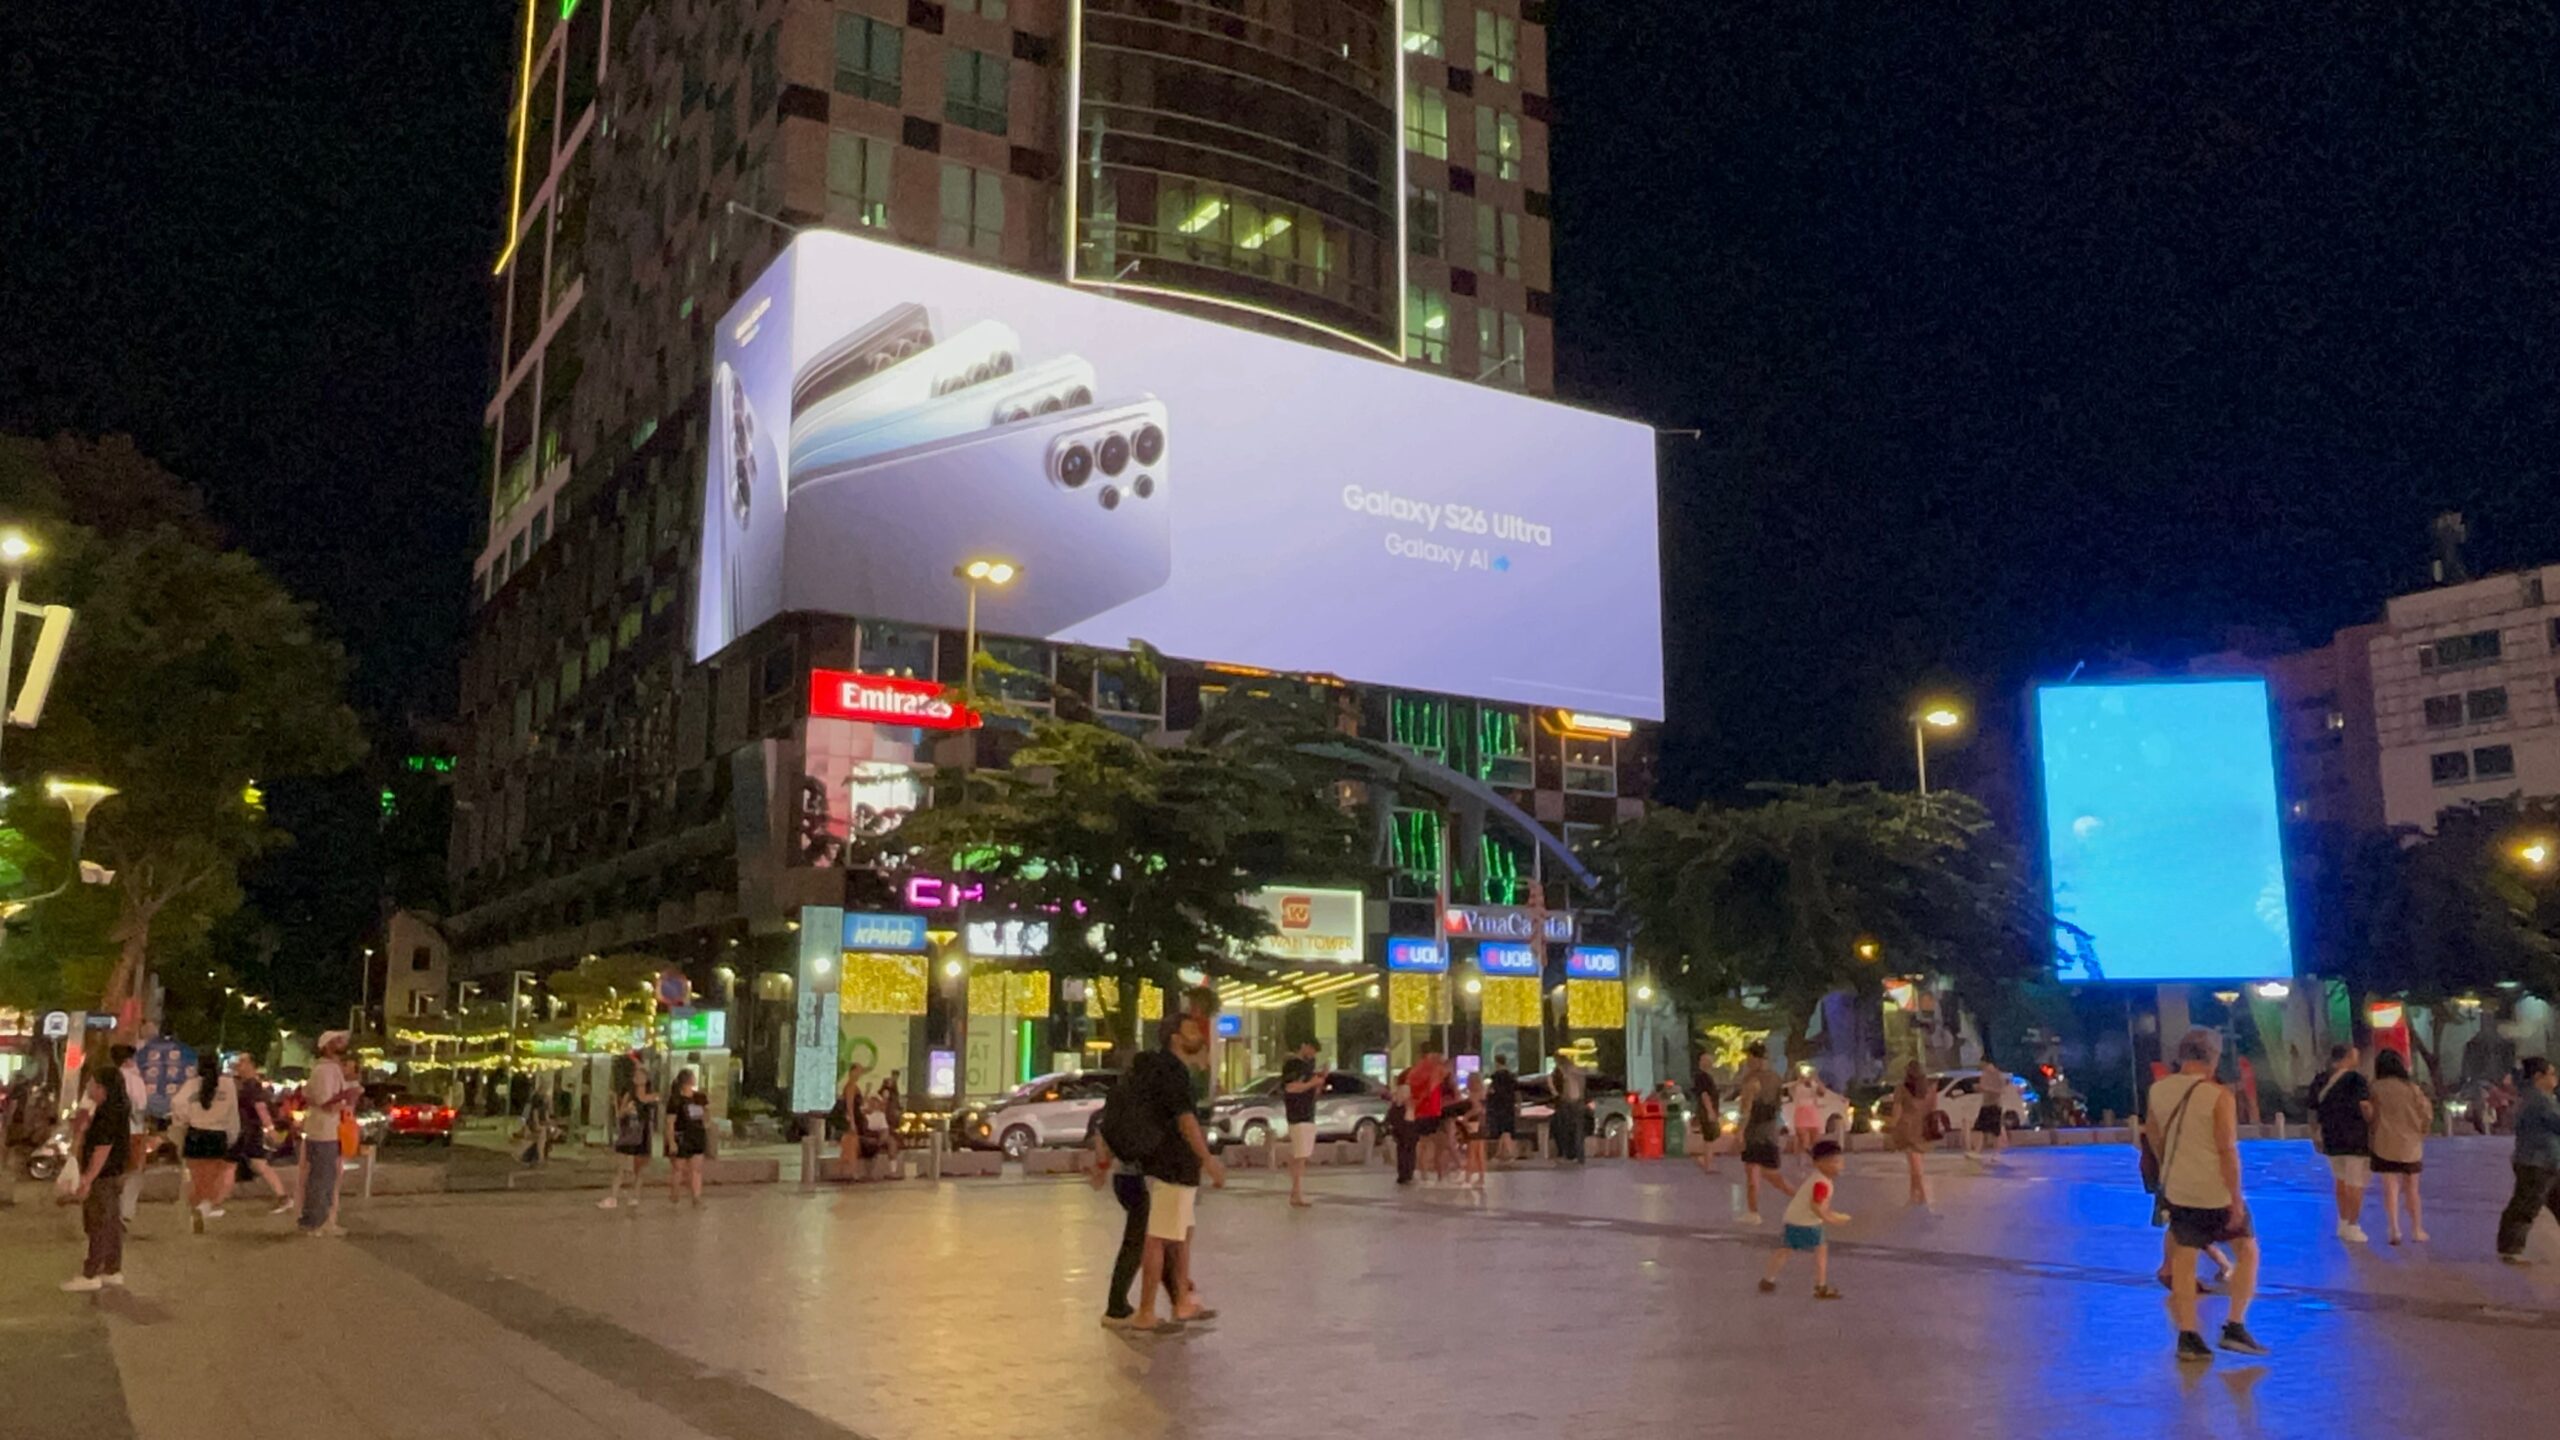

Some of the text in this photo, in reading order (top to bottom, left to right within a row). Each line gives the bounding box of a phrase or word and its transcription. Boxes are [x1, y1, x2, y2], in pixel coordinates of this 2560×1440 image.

[1343, 484, 1552, 546] Galaxy S26 Ultra
[1385, 533, 1464, 571] Galaxy
[1463, 907, 1574, 937] VinaCaital
[853, 928, 913, 946] KPMG
[1306, 935, 1354, 951] TOWER
[1500, 949, 1534, 968] UOB
[1584, 954, 1617, 971] UOB
